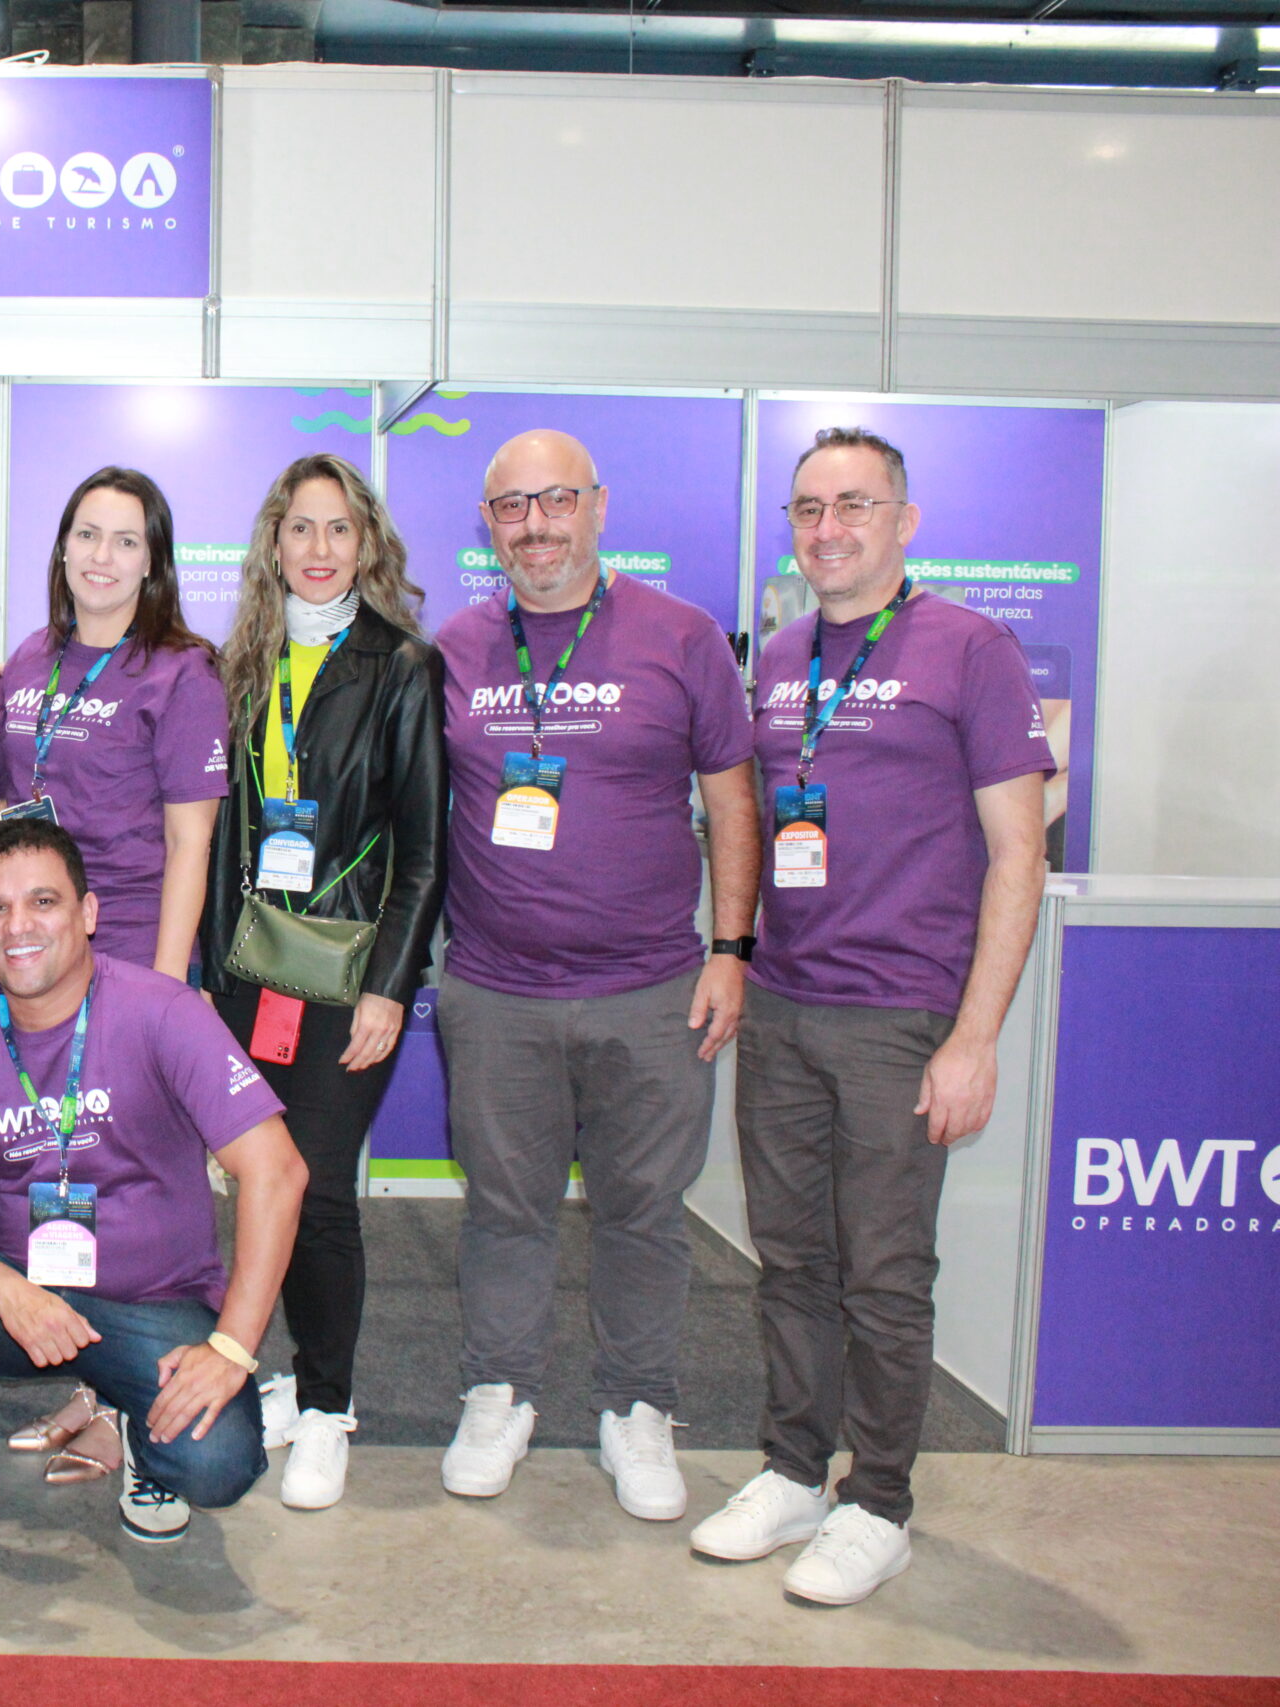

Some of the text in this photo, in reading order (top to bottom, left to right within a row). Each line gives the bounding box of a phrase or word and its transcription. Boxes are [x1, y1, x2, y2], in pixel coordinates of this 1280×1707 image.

[48, 216, 177, 230] TURISMO
[463, 551, 488, 566] Os
[181, 570, 240, 585] para os
[954, 563, 1072, 580] sustentáveis:
[186, 591, 217, 602] ano
[983, 586, 1012, 602] prol
[1015, 586, 1043, 600] das
[976, 606, 1033, 619] atureza.
[781, 830, 819, 841] EXPOSITOR
[1073, 1137, 1256, 1208] BWT
